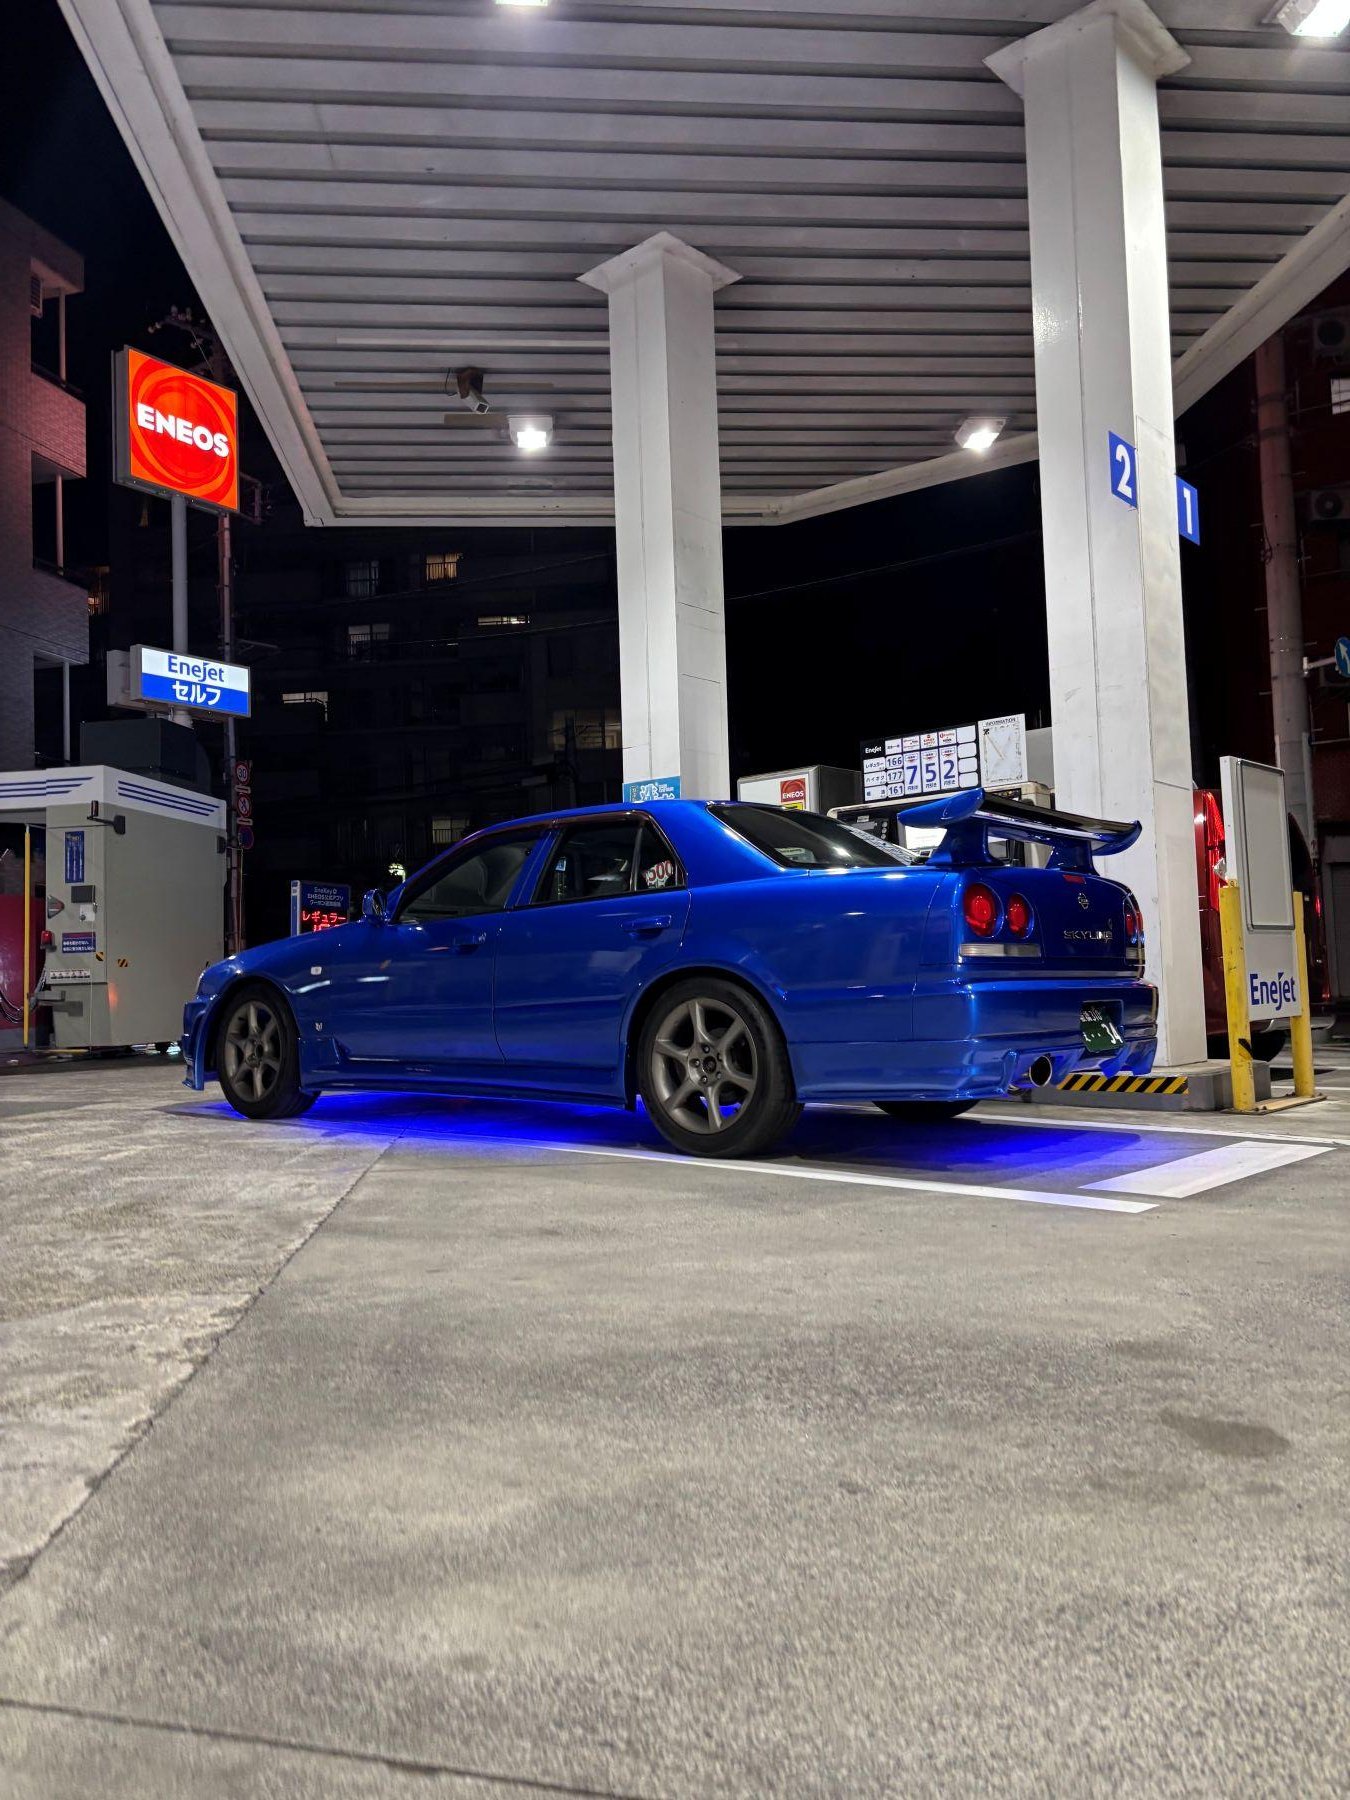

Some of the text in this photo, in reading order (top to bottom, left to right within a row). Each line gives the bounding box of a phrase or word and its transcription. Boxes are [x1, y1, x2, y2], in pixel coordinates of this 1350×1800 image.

[137, 402, 229, 457] ENEOS
[1115, 444, 1132, 499] 2
[1183, 487, 1193, 535] 1
[168, 655, 224, 682] Enejet
[172, 680, 221, 706] セルフ
[865, 745, 882, 754] Enejet
[887, 756, 902, 767] 166
[943, 760, 956, 780] 2
[887, 771, 903, 781] 177
[906, 765, 917, 785] 7
[925, 763, 937, 783] 5
[782, 791, 804, 799] ENEOS
[888, 785, 904, 795] 161
[302, 911, 346, 922] レギュラー
[1250, 972, 1296, 1011] Enejet
